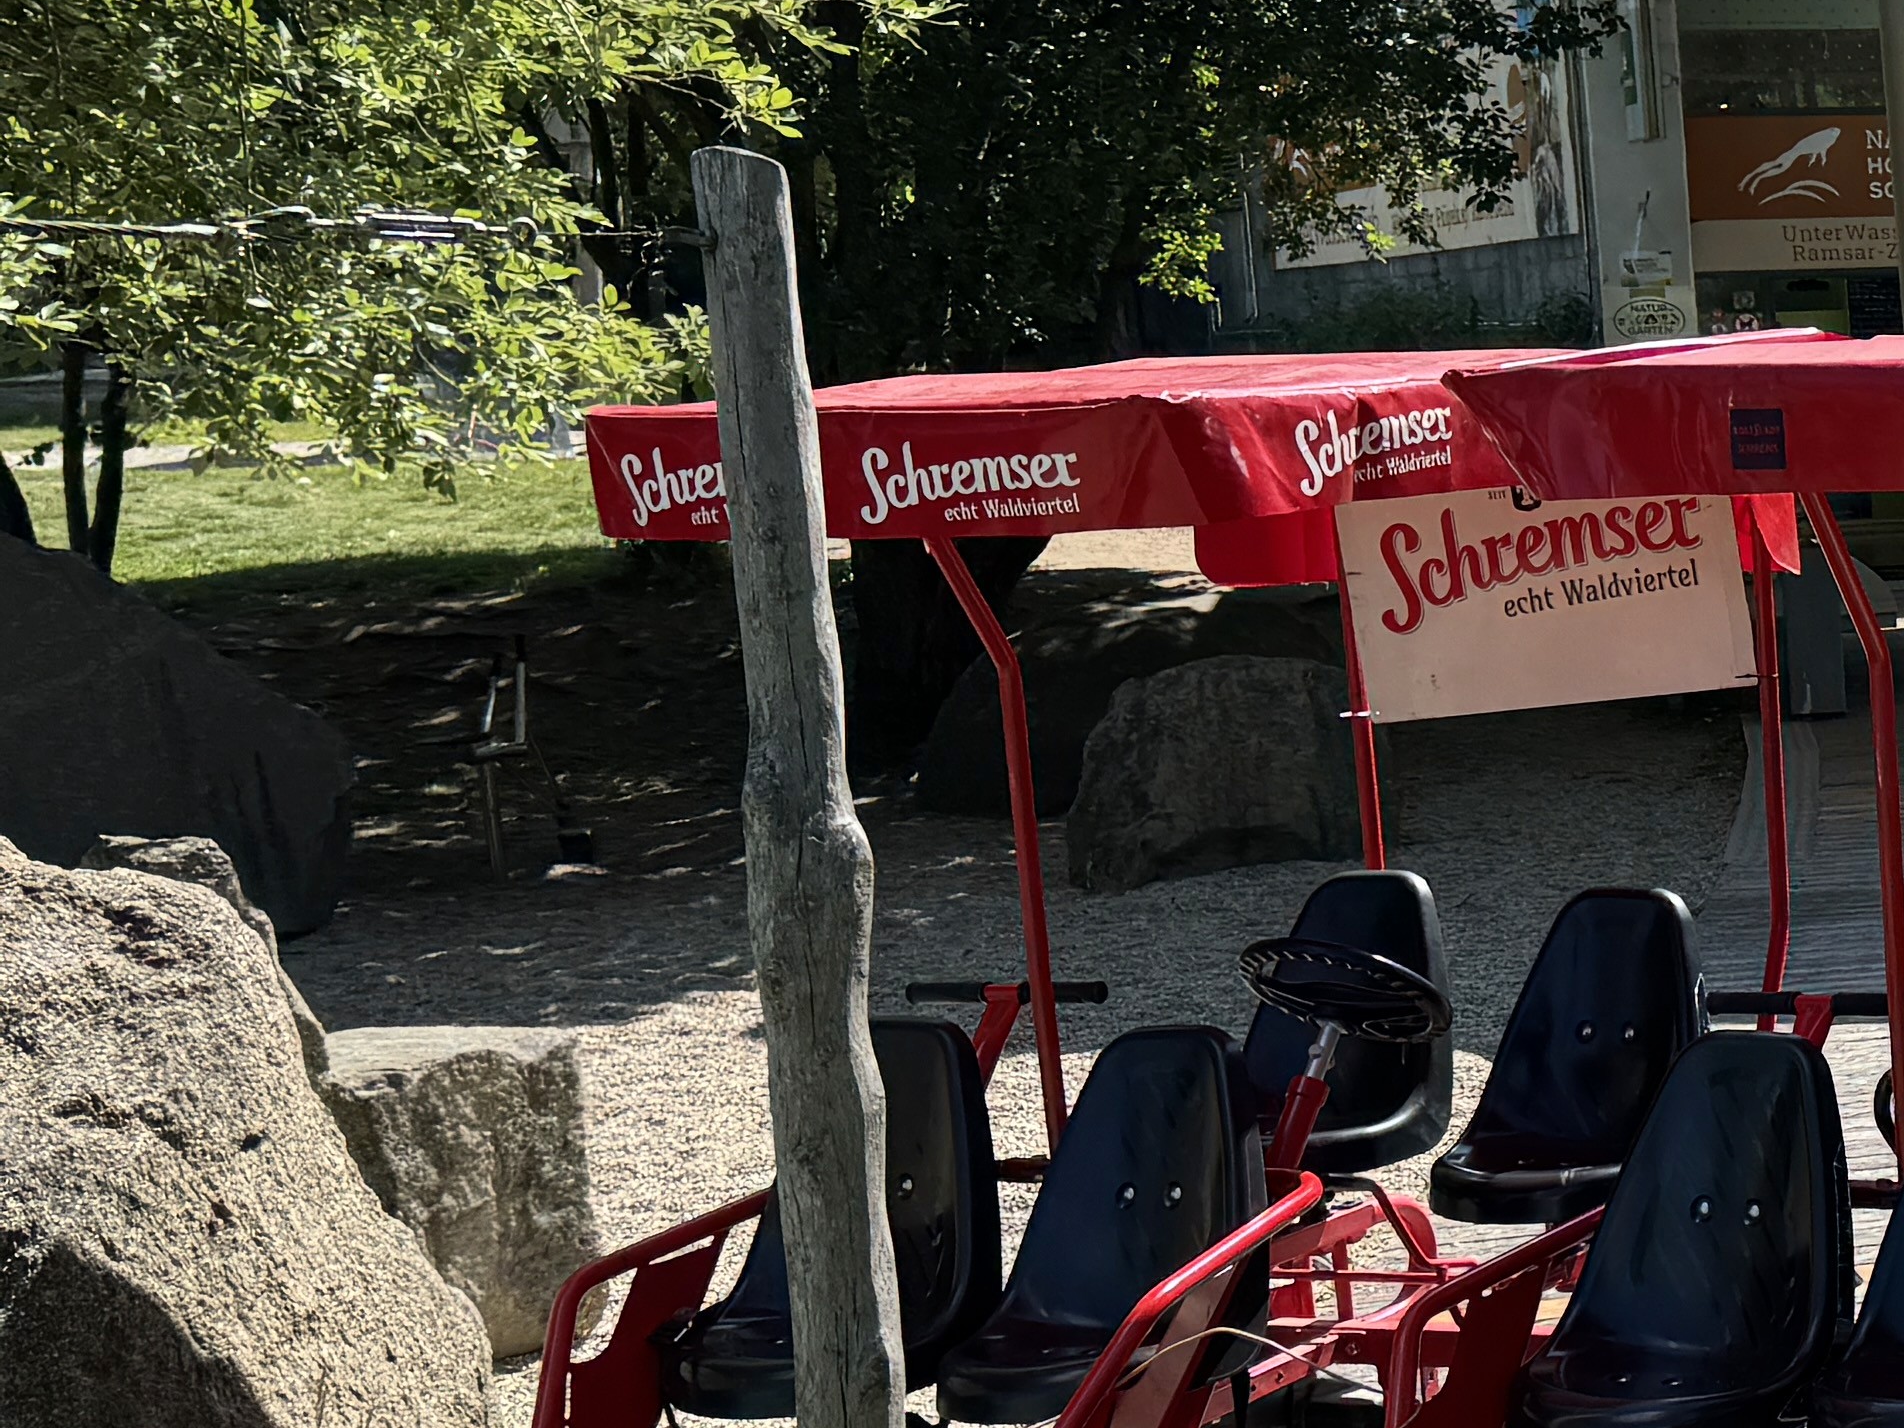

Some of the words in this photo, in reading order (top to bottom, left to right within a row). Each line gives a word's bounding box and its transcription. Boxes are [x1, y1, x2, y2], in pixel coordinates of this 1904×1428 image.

[861, 441, 1079, 524] Schremser
[1295, 405, 1453, 497] Schremser
[1386, 444, 1452, 476] Waldviertel
[944, 500, 979, 521] echt
[985, 492, 1080, 519] Waldviertel
[1380, 496, 1705, 634] Schremser
[1503, 588, 1553, 617] echt
[1561, 559, 1699, 606] Waldviertel
